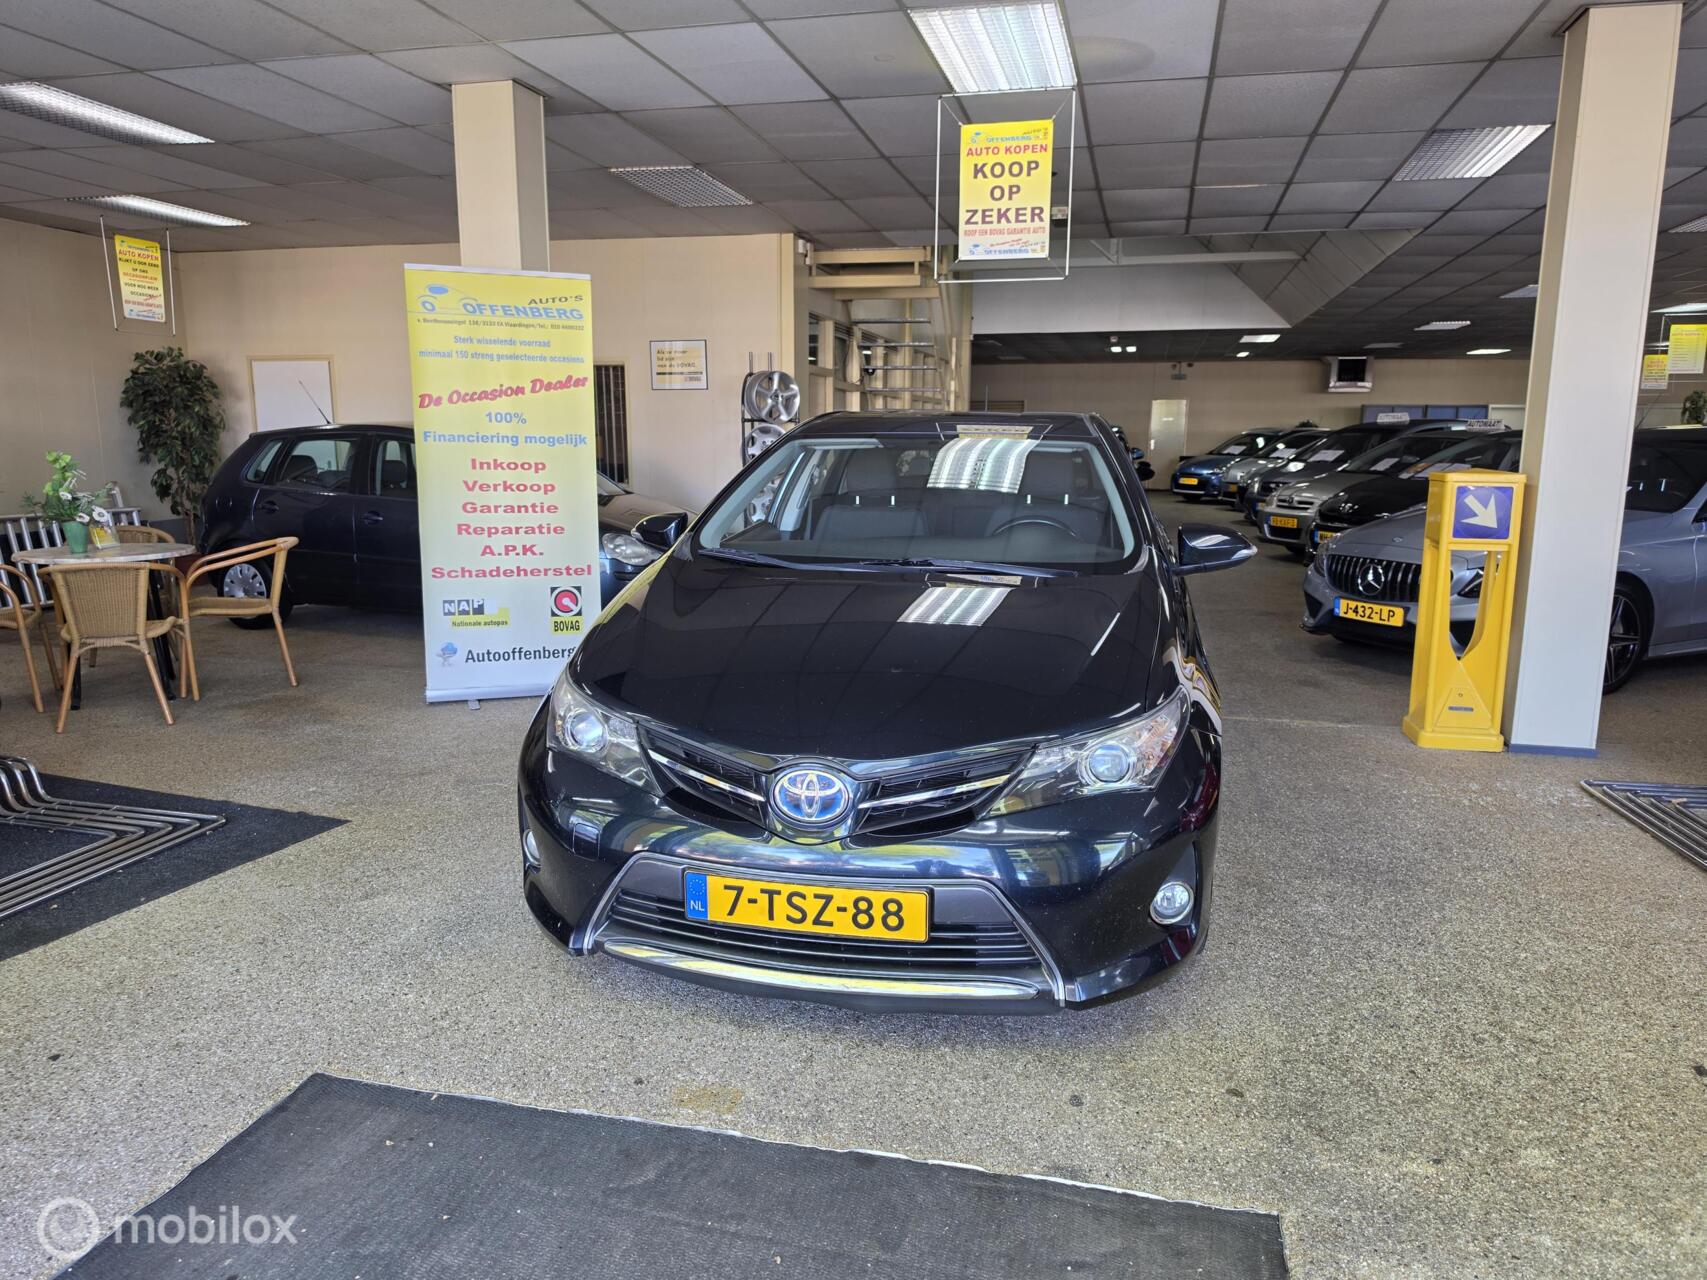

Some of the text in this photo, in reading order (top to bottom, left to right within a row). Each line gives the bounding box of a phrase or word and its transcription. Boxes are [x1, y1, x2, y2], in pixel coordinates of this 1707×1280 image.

[966, 144, 1048, 157] AUTO KOPEN
[973, 160, 1040, 179] KOOP
[989, 185, 1021, 201] OP
[964, 206, 1045, 225] ZEKER
[118, 249, 160, 261] AUTO KOPEN
[528, 294, 584, 305] AUTO'S
[462, 302, 584, 320] OFFENBERG
[454, 336, 551, 348] Sterk wisselende voorraad
[419, 350, 585, 364] minimaal 150 streng geselecteerde occasions
[419, 375, 589, 409] De Occasion Dealer
[485, 411, 528, 424] 100%
[423, 431, 588, 447] Financiering mogelijk
[470, 458, 547, 473] Inkoop
[463, 480, 557, 495] Verkoop
[461, 501, 559, 514] Garantie
[456, 523, 566, 538] Reparatie
[480, 544, 544, 556] A.P.K.
[431, 564, 593, 579] Schadeherstel
[443, 599, 484, 615] NAP
[1343, 602, 1395, 622] J-432-LP
[483, 619, 508, 628] autopas
[553, 620, 580, 632] BOVAG
[465, 646, 577, 664] Autooffenberg
[690, 884, 905, 932] NL 7-TSZ-88
